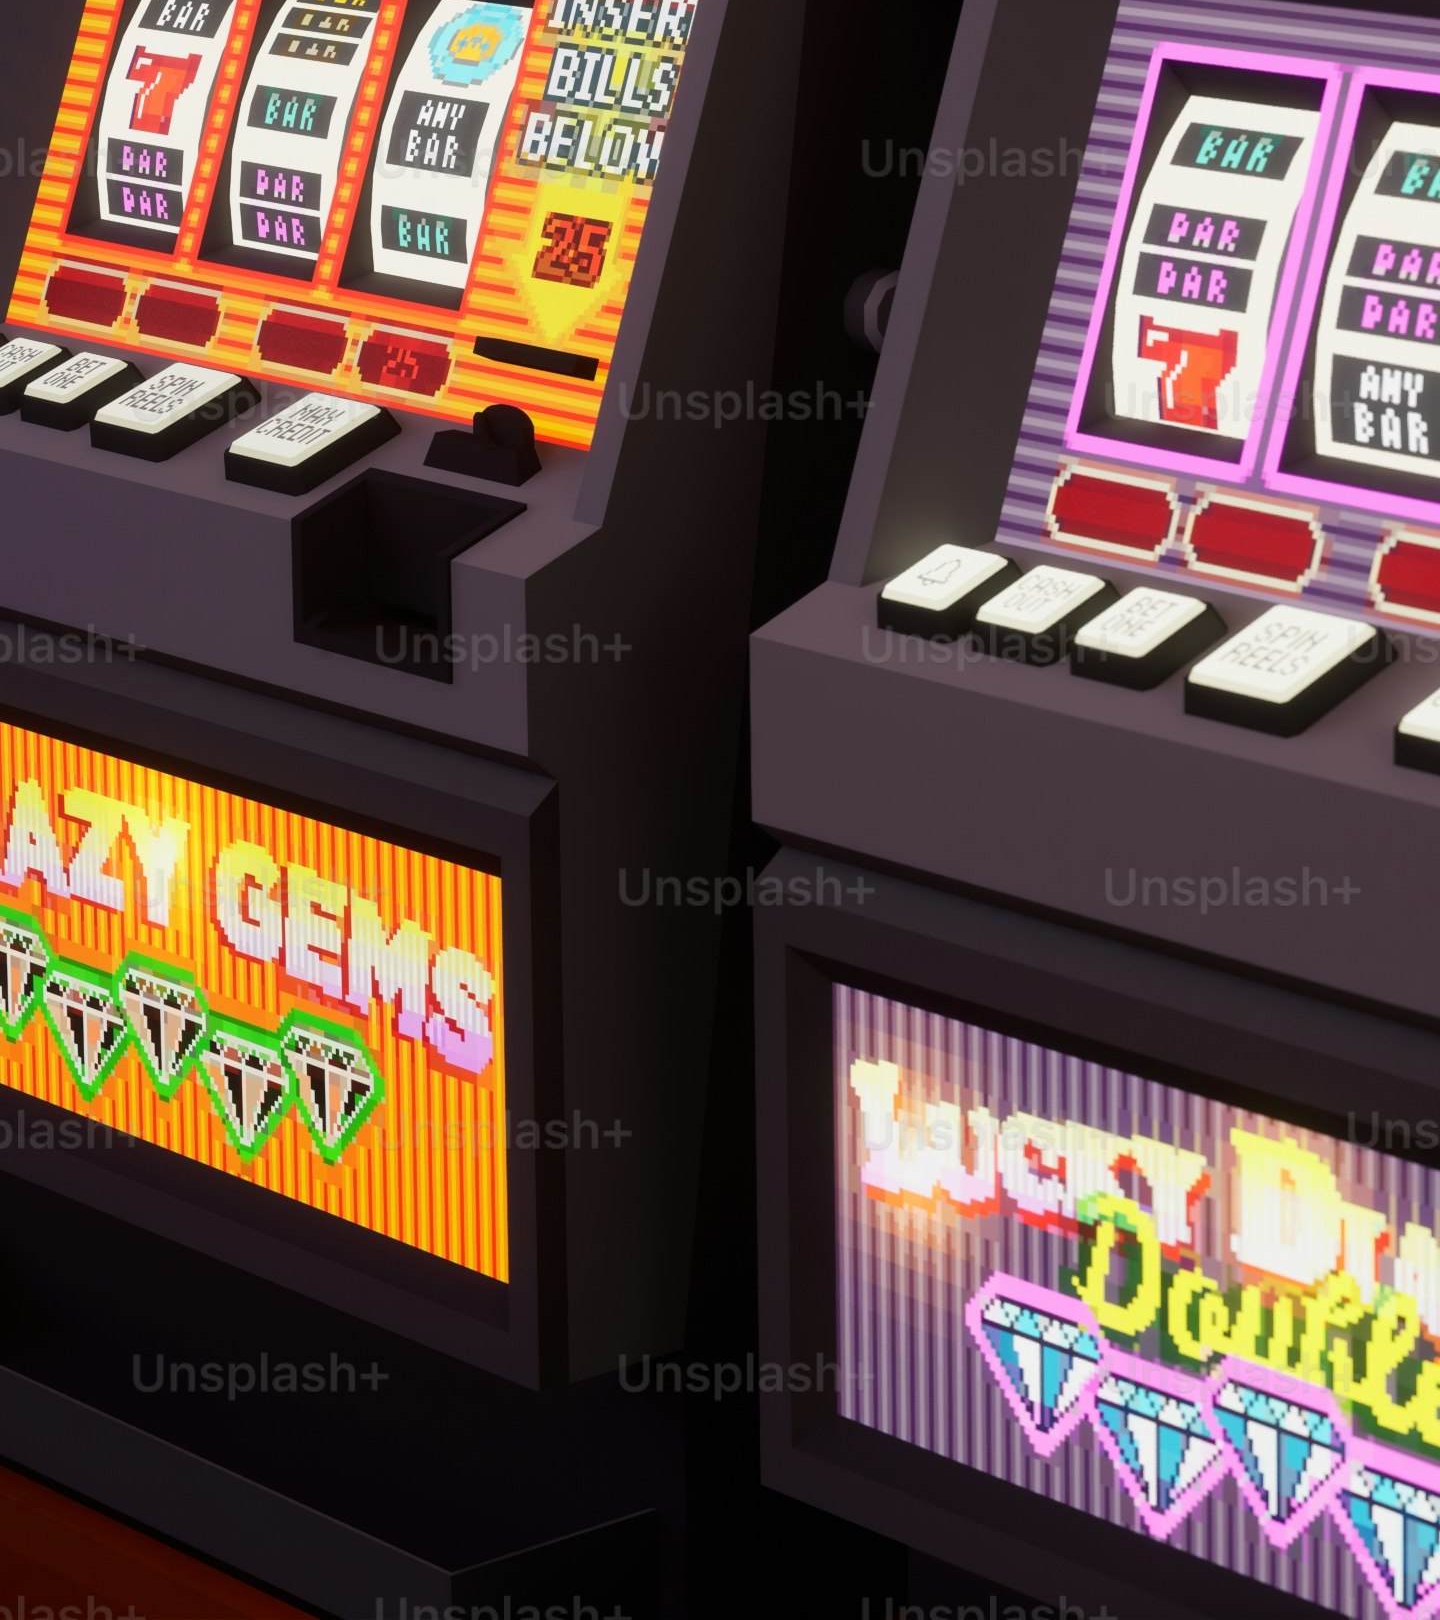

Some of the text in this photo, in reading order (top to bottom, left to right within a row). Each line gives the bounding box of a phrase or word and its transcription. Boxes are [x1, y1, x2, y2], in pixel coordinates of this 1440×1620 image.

[125, 45, 202, 135] 7
[546, 44, 676, 113] BILLS
[416, 98, 466, 132] ANY
[404, 131, 458, 170] BAR
[1195, 130, 1276, 172] BAR
[397, 214, 450, 256] BAR
[531, 212, 613, 288] 25
[43, 371, 86, 391] ONE
[73, 357, 108, 374] BET
[1138, 315, 1238, 430] 7
[117, 389, 176, 415] REELS
[150, 375, 206, 397] SPIN
[1360, 366, 1424, 409] ANY
[290, 403, 346, 426] MAX
[1354, 402, 1429, 455] BAR
[255, 419, 332, 445] CREDIT
[1001, 590, 1049, 616] OUT
[1019, 572, 1082, 602] CASH
[1130, 594, 1181, 618] BET
[1100, 610, 1156, 640] ONE
[1254, 621, 1330, 652] SPIN
[1219, 641, 1302, 678] REELS
[210, 838, 496, 1075] GEMS
